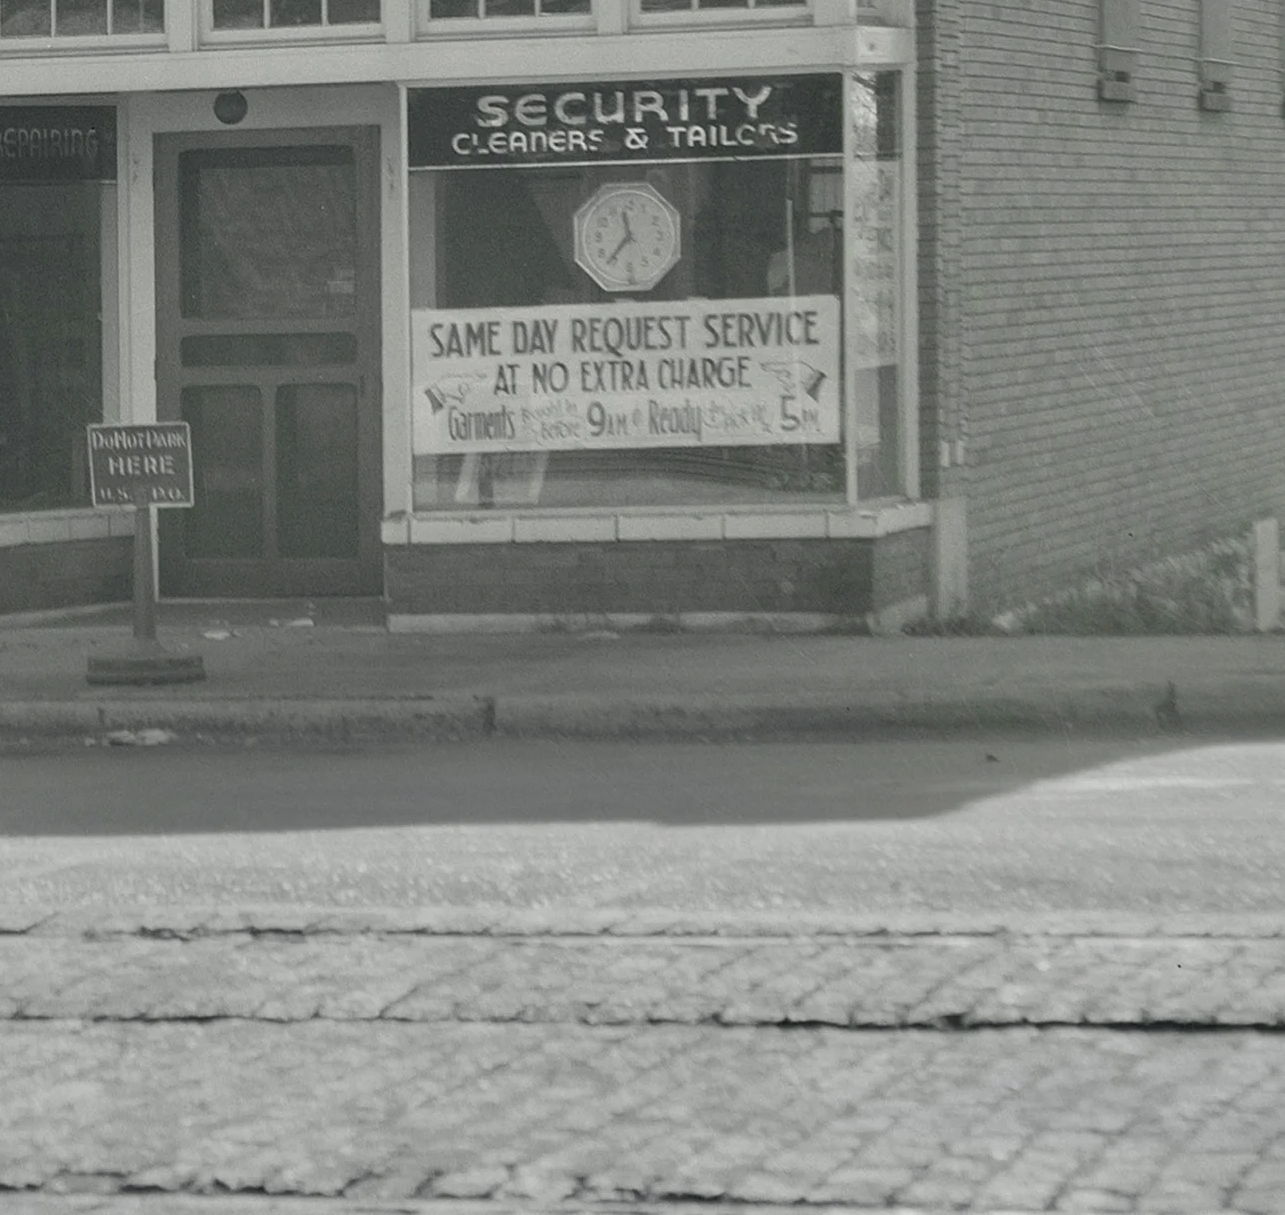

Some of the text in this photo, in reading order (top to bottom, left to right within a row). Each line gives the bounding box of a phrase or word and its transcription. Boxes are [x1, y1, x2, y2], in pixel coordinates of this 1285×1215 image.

[476, 86, 772, 129] SECURITY
[451, 129, 604, 156] CLEANERS
[624, 127, 650, 150] &
[430, 310, 821, 359] SAME DAY REQUEST SERVICE
[493, 355, 753, 396] AT NO EXTRA CHARGE
[146, 430, 186, 449] PARK
[448, 404, 516, 441] Garments
[648, 399, 703, 442] Ready
[108, 456, 176, 476] HERE
